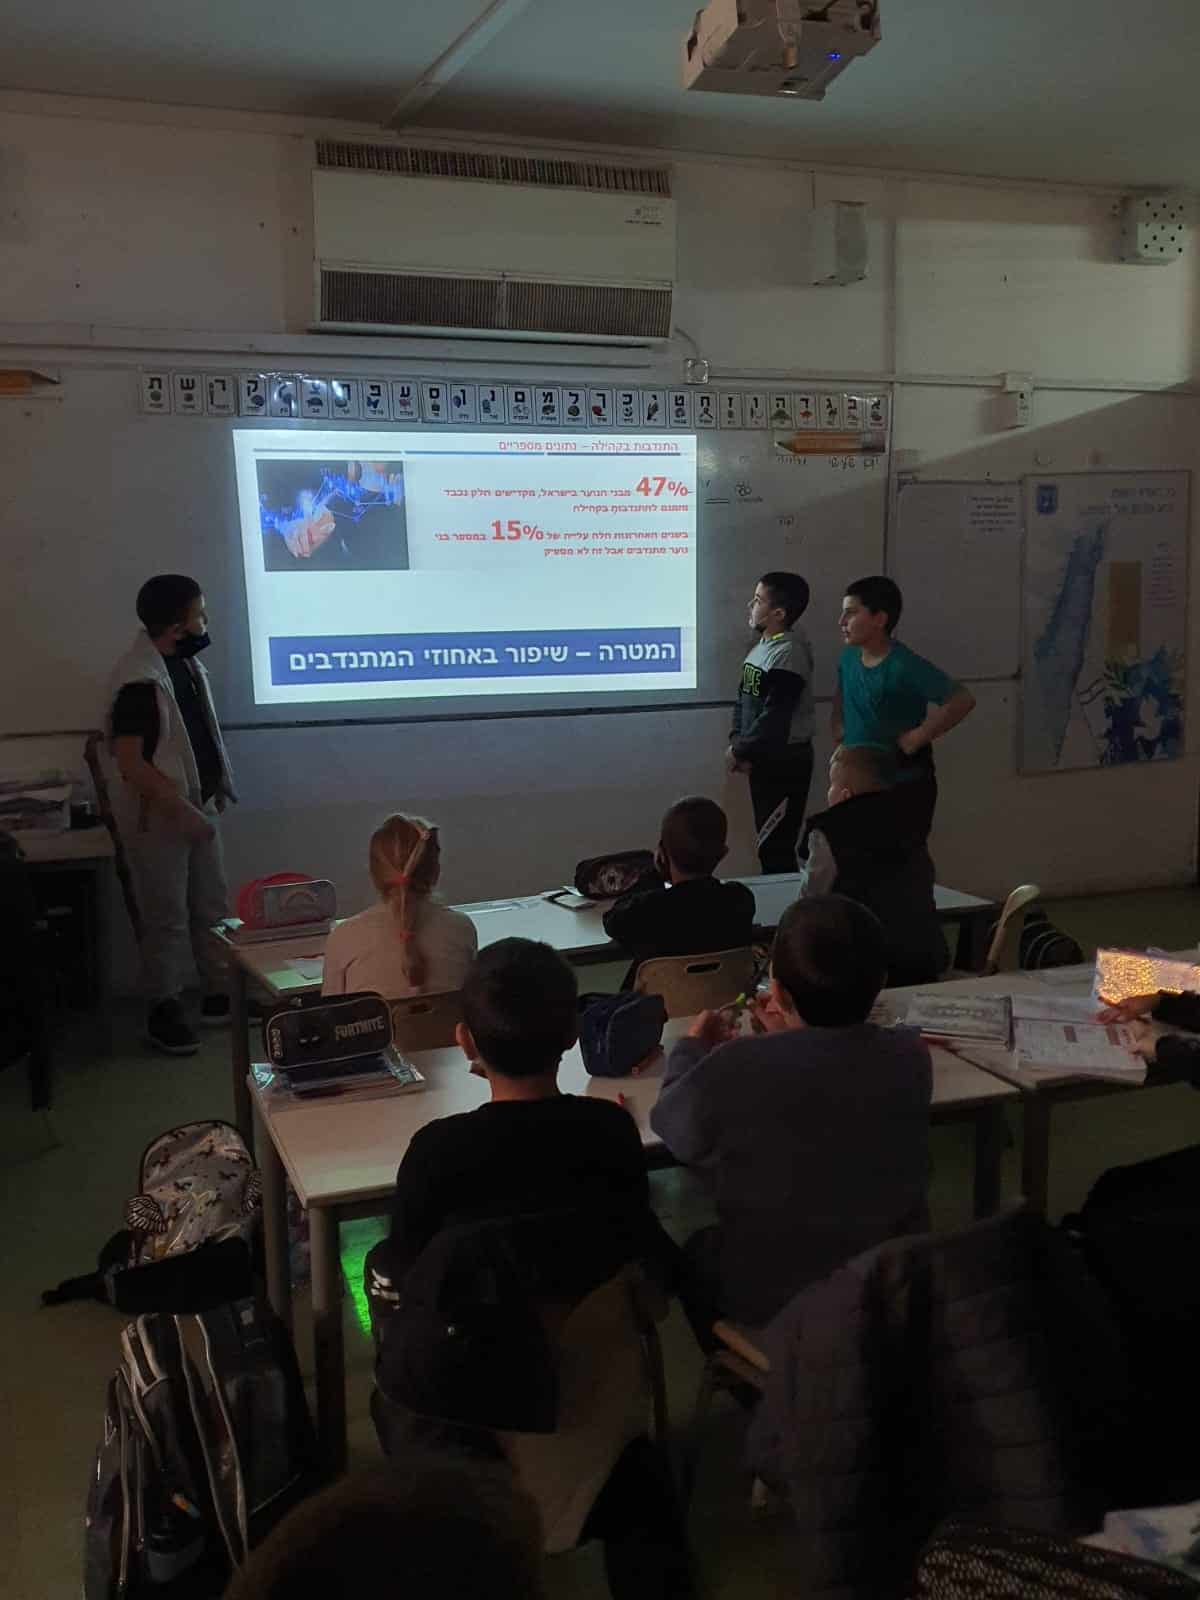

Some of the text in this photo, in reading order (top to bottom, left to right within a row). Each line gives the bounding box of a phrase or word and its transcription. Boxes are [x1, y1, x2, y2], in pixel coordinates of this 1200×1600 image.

[148, 377, 162, 389] ת
[181, 378, 195, 390] ש
[214, 379, 226, 392] ר
[247, 380, 258, 397] ק
[370, 385, 381, 397] פ
[400, 386, 410, 398] ע
[429, 388, 440, 399] ס
[460, 389, 466, 405] ן
[490, 390, 495, 402] נ
[514, 391, 525, 402] ם
[542, 391, 553, 403] מ
[568, 391, 579, 405] ל
[596, 393, 606, 409] ך
[622, 394, 632, 405] כ
[675, 395, 684, 406] ט
[700, 396, 710, 407] ח
[728, 397, 733, 408] ז
[753, 397, 758, 409] ו
[776, 397, 785, 409] ה
[800, 398, 809, 409] ד
[826, 398, 832, 409] ג
[499, 441, 544, 450] מספריים
[546, 441, 577, 451] נתונים
[591, 440, 630, 453] בקהילה
[636, 476, 689, 497] 47%
[443, 489, 468, 497] נכבד
[471, 487, 491, 499] חלק
[495, 489, 536, 499] מקדישים
[580, 489, 608, 498] הנוער
[610, 489, 631, 497] מבני
[572, 503, 609, 515] בקהילה
[491, 519, 545, 541] 15%
[546, 531, 561, 540] של
[591, 531, 612, 540] חלה
[614, 532, 658, 540] האחרונות
[660, 532, 689, 540] בשנים
[434, 532, 450, 541] בני
[451, 532, 487, 541] במספר
[543, 547, 689, 558] נוער מתנדבים אבל זה לא מספיק
[423, 648, 499, 667] באחוזי
[504, 645, 569, 663] שיפור
[598, 643, 676, 661] המטרה
[288, 650, 416, 672] המתנדבים
[335, 1015, 386, 1040] FORTNITE
